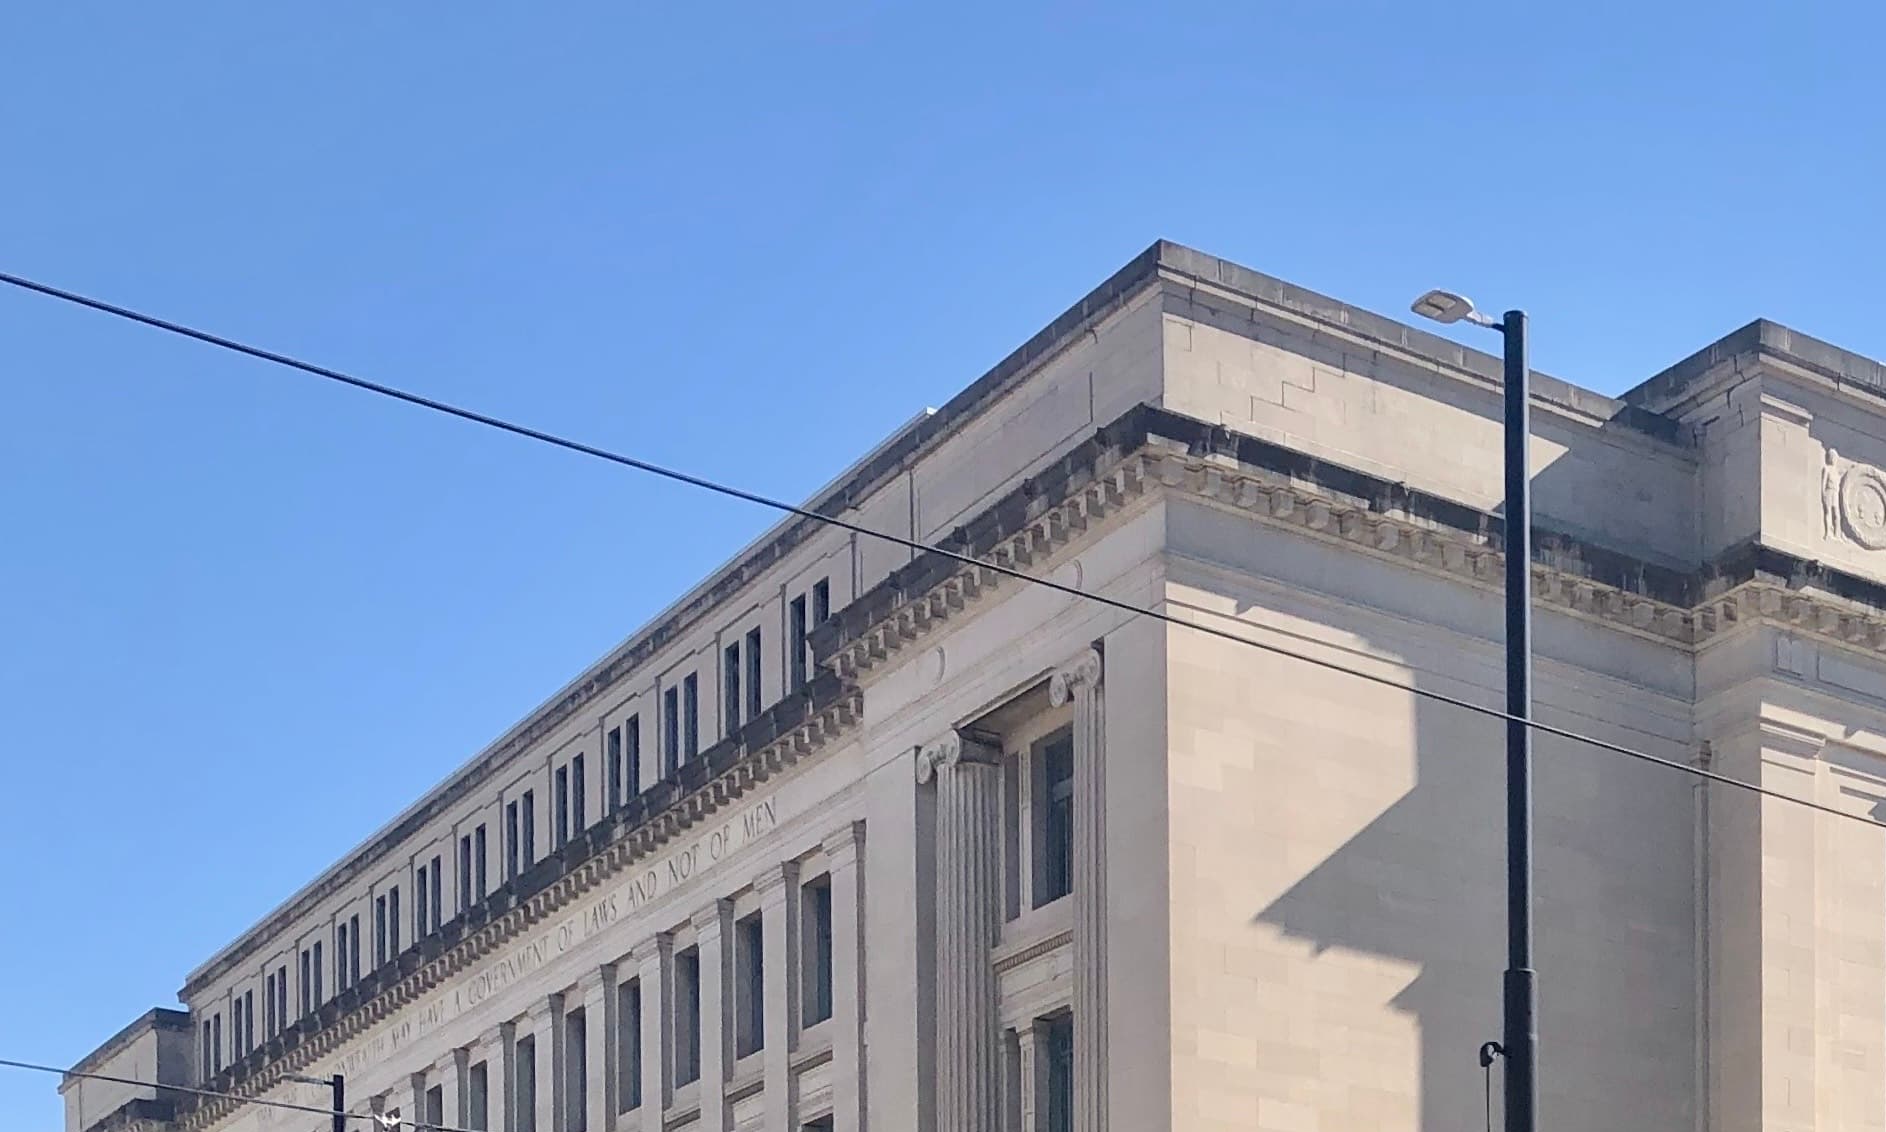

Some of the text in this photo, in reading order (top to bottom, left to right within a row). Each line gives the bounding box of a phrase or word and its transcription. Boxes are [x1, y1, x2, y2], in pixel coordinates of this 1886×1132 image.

[467, 934, 549, 1005] GOVERNMENT
[557, 919, 576, 952] OF
[583, 893, 617, 938] LAWS
[628, 870, 657, 909] AND
[667, 843, 701, 880] NOT
[710, 824, 730, 861] OF
[742, 796, 777, 845] MEN
